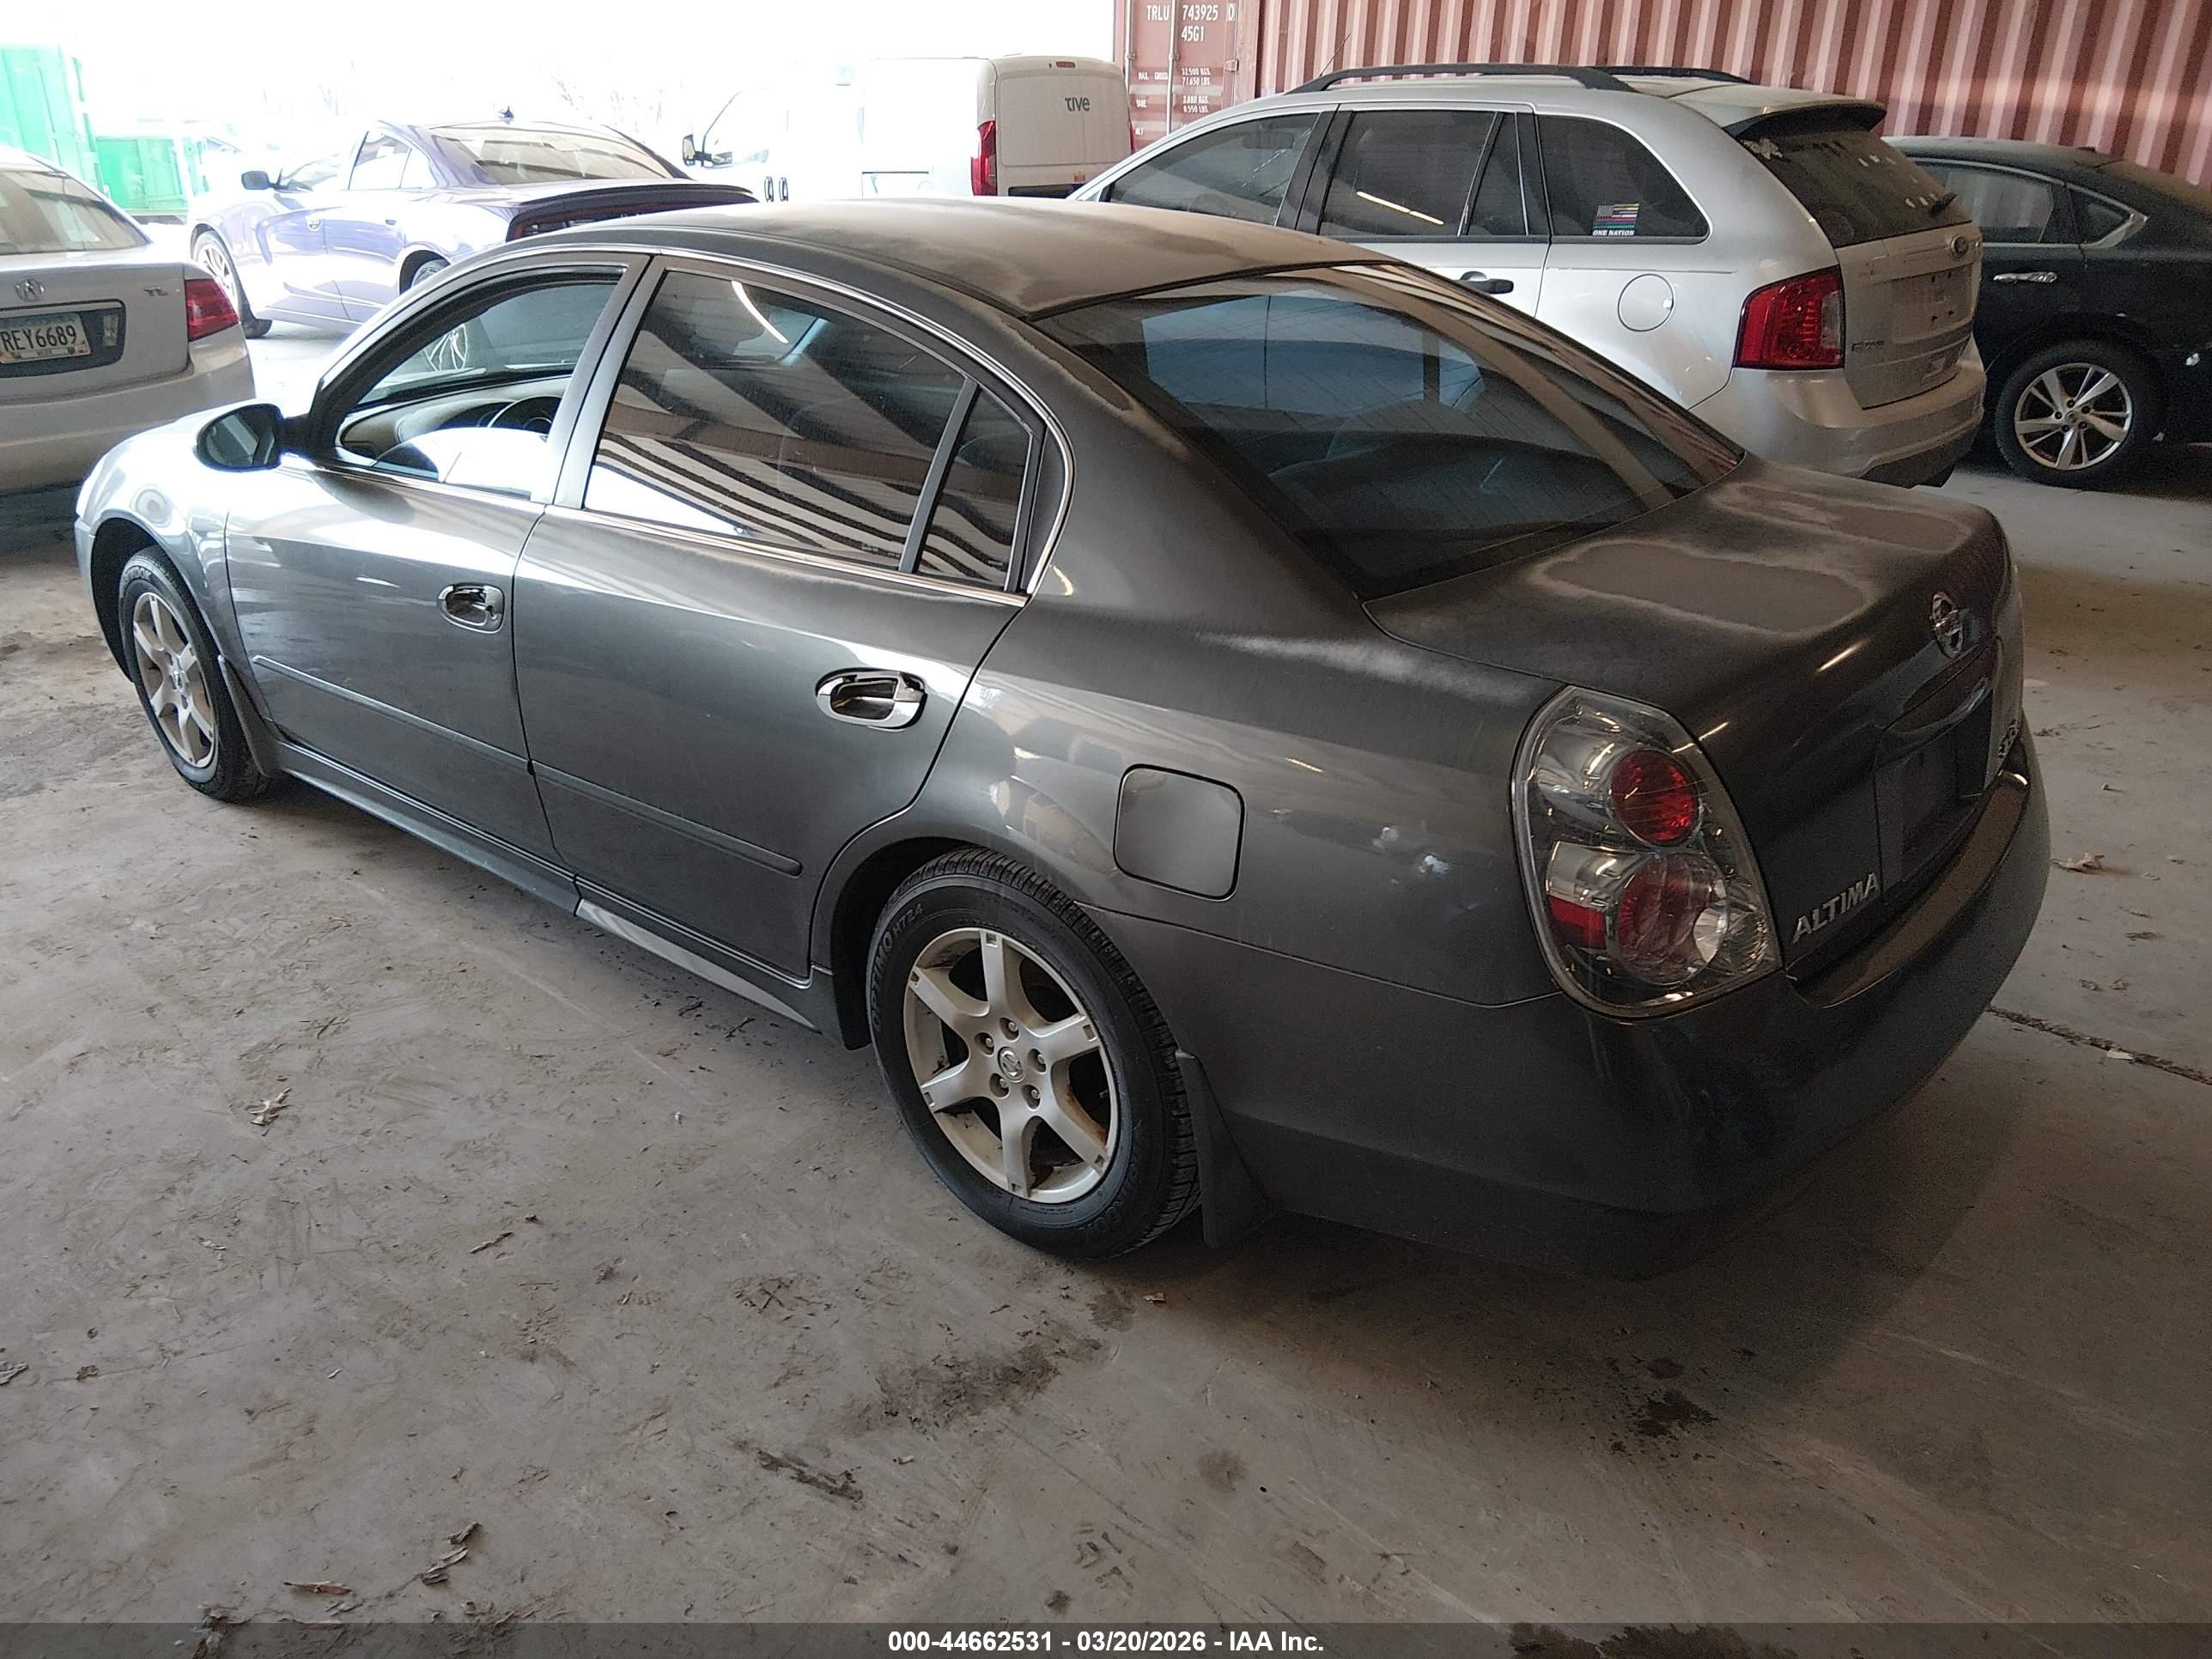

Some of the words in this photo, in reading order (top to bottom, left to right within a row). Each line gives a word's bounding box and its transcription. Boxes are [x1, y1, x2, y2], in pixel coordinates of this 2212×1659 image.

[1146, 4, 1170, 21] TRLU
[1182, 4, 1218, 21] 743925
[1227, 4, 1236, 21] 0
[1182, 26, 1204, 41] 45G1
[0, 325, 77, 352] REY6689
[1793, 872, 1880, 944] ALTIMA
